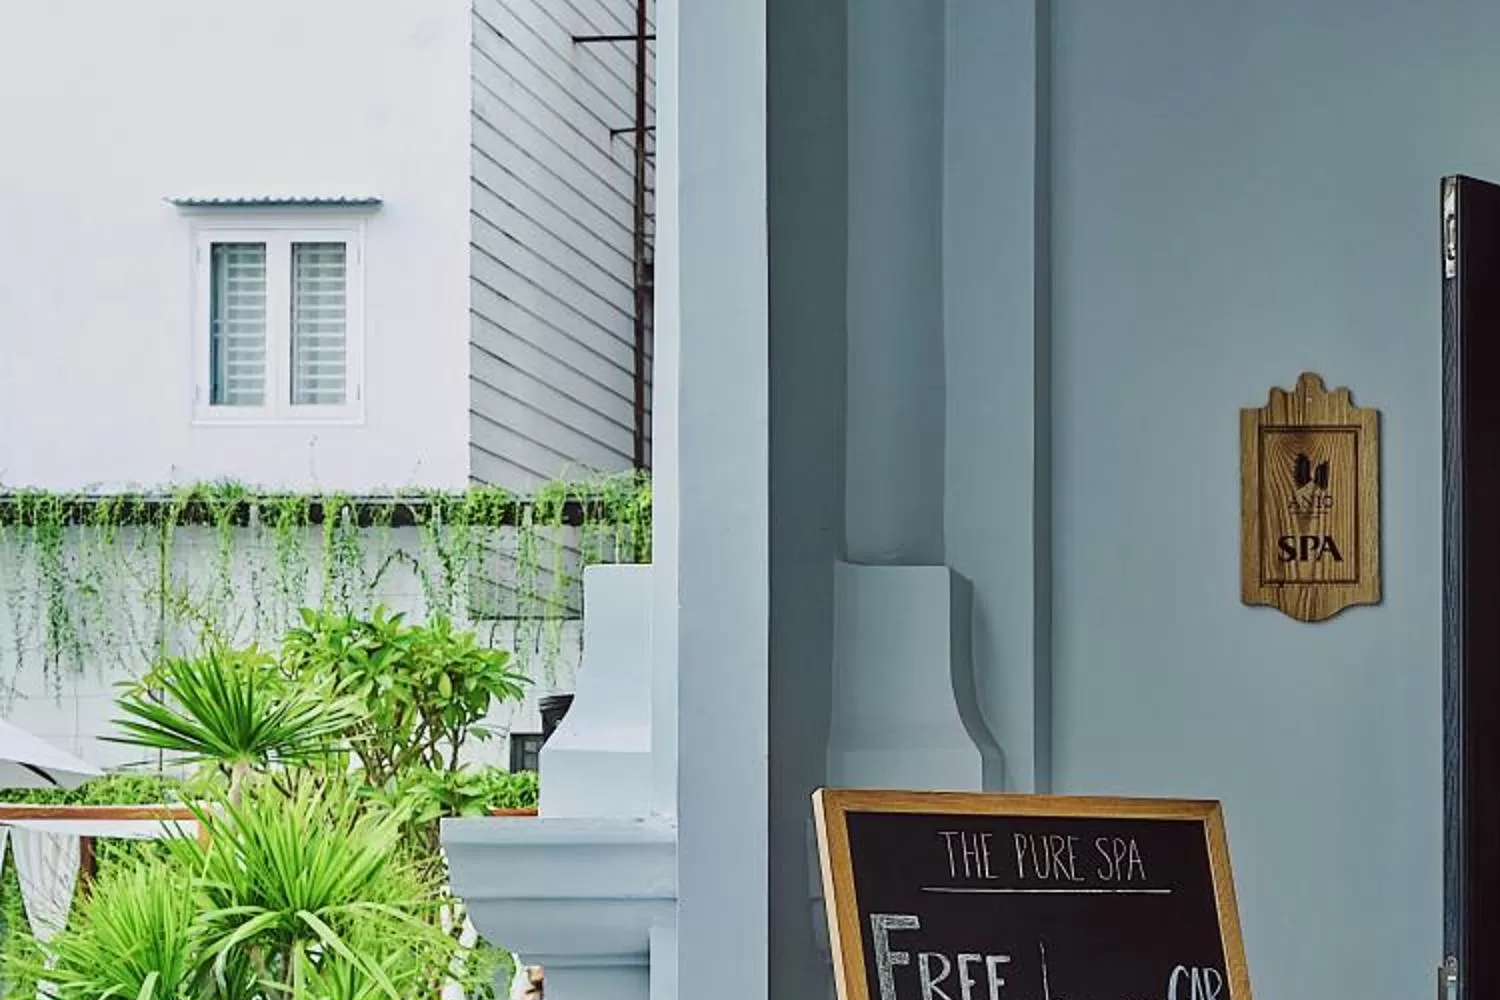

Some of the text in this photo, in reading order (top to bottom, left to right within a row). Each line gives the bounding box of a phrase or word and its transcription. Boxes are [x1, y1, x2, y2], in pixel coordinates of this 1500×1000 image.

[1278, 535, 1343, 562] SPA
[938, 831, 1146, 881] THE PURE SPA
